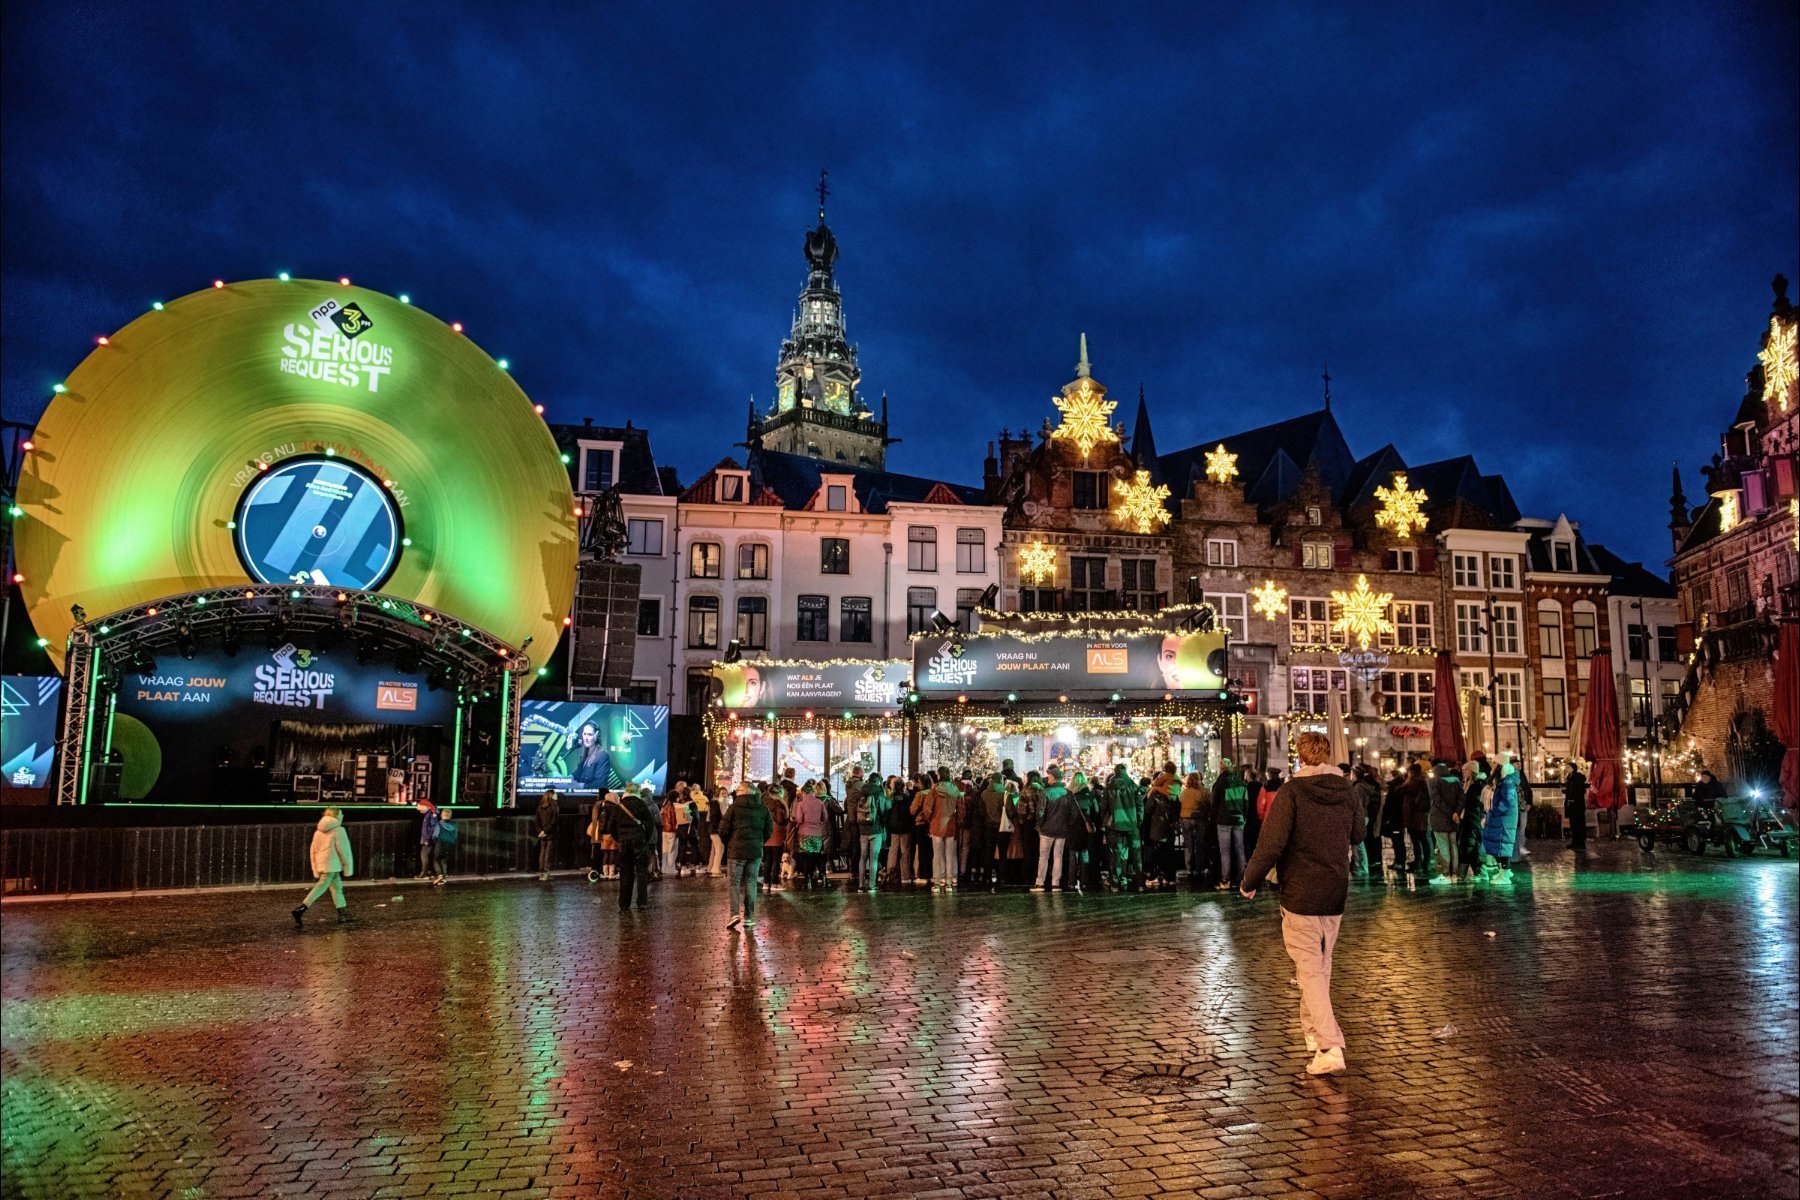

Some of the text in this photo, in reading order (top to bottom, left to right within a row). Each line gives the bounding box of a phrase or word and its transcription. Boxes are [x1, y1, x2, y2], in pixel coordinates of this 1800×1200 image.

[312, 301, 337, 320] npo
[281, 323, 393, 366] SERIOUS
[280, 358, 391, 393] REQUEST
[273, 442, 296, 457] NU
[275, 645, 293, 661] npo
[996, 652, 1037, 660] VRAAG NU
[1091, 652, 1124, 666] ALS
[928, 656, 978, 675] SERIOUS
[996, 662, 1070, 671] JOUW PLAAT AAN!
[138, 675, 227, 688] VRAAG JOUW
[254, 664, 335, 691] SERIOUS
[928, 670, 977, 686] REQUEST
[854, 679, 895, 695] SERIOUS
[137, 690, 211, 703] PLAAT AAN
[253, 689, 333, 710] REQUEST
[382, 690, 414, 703] ALS
[854, 690, 893, 704] REQUEST
